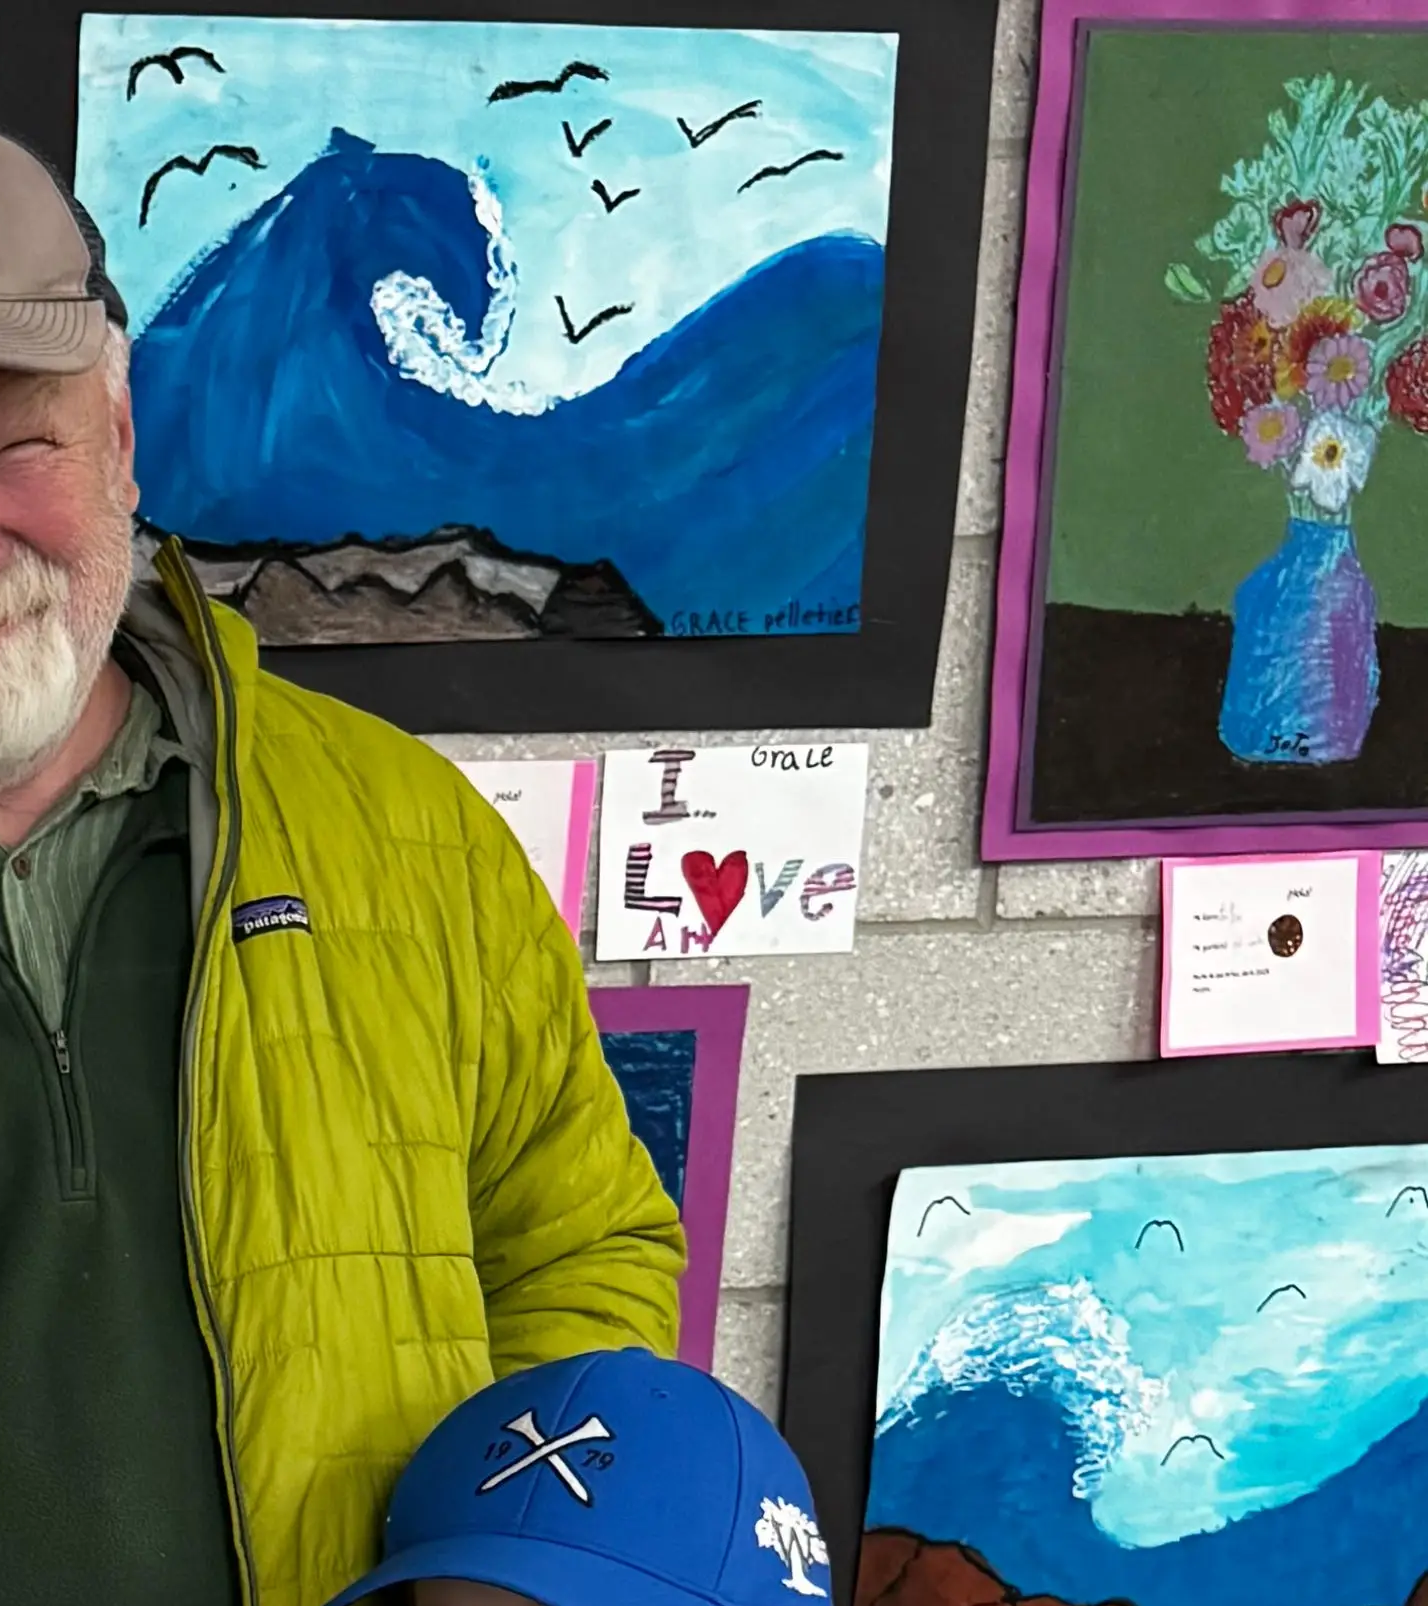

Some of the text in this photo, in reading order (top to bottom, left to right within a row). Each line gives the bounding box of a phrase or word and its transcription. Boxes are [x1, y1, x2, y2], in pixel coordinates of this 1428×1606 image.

[671, 610, 751, 637] GRACE
[643, 916, 716, 955] Art
[483, 1440, 616, 1471] 19 79
